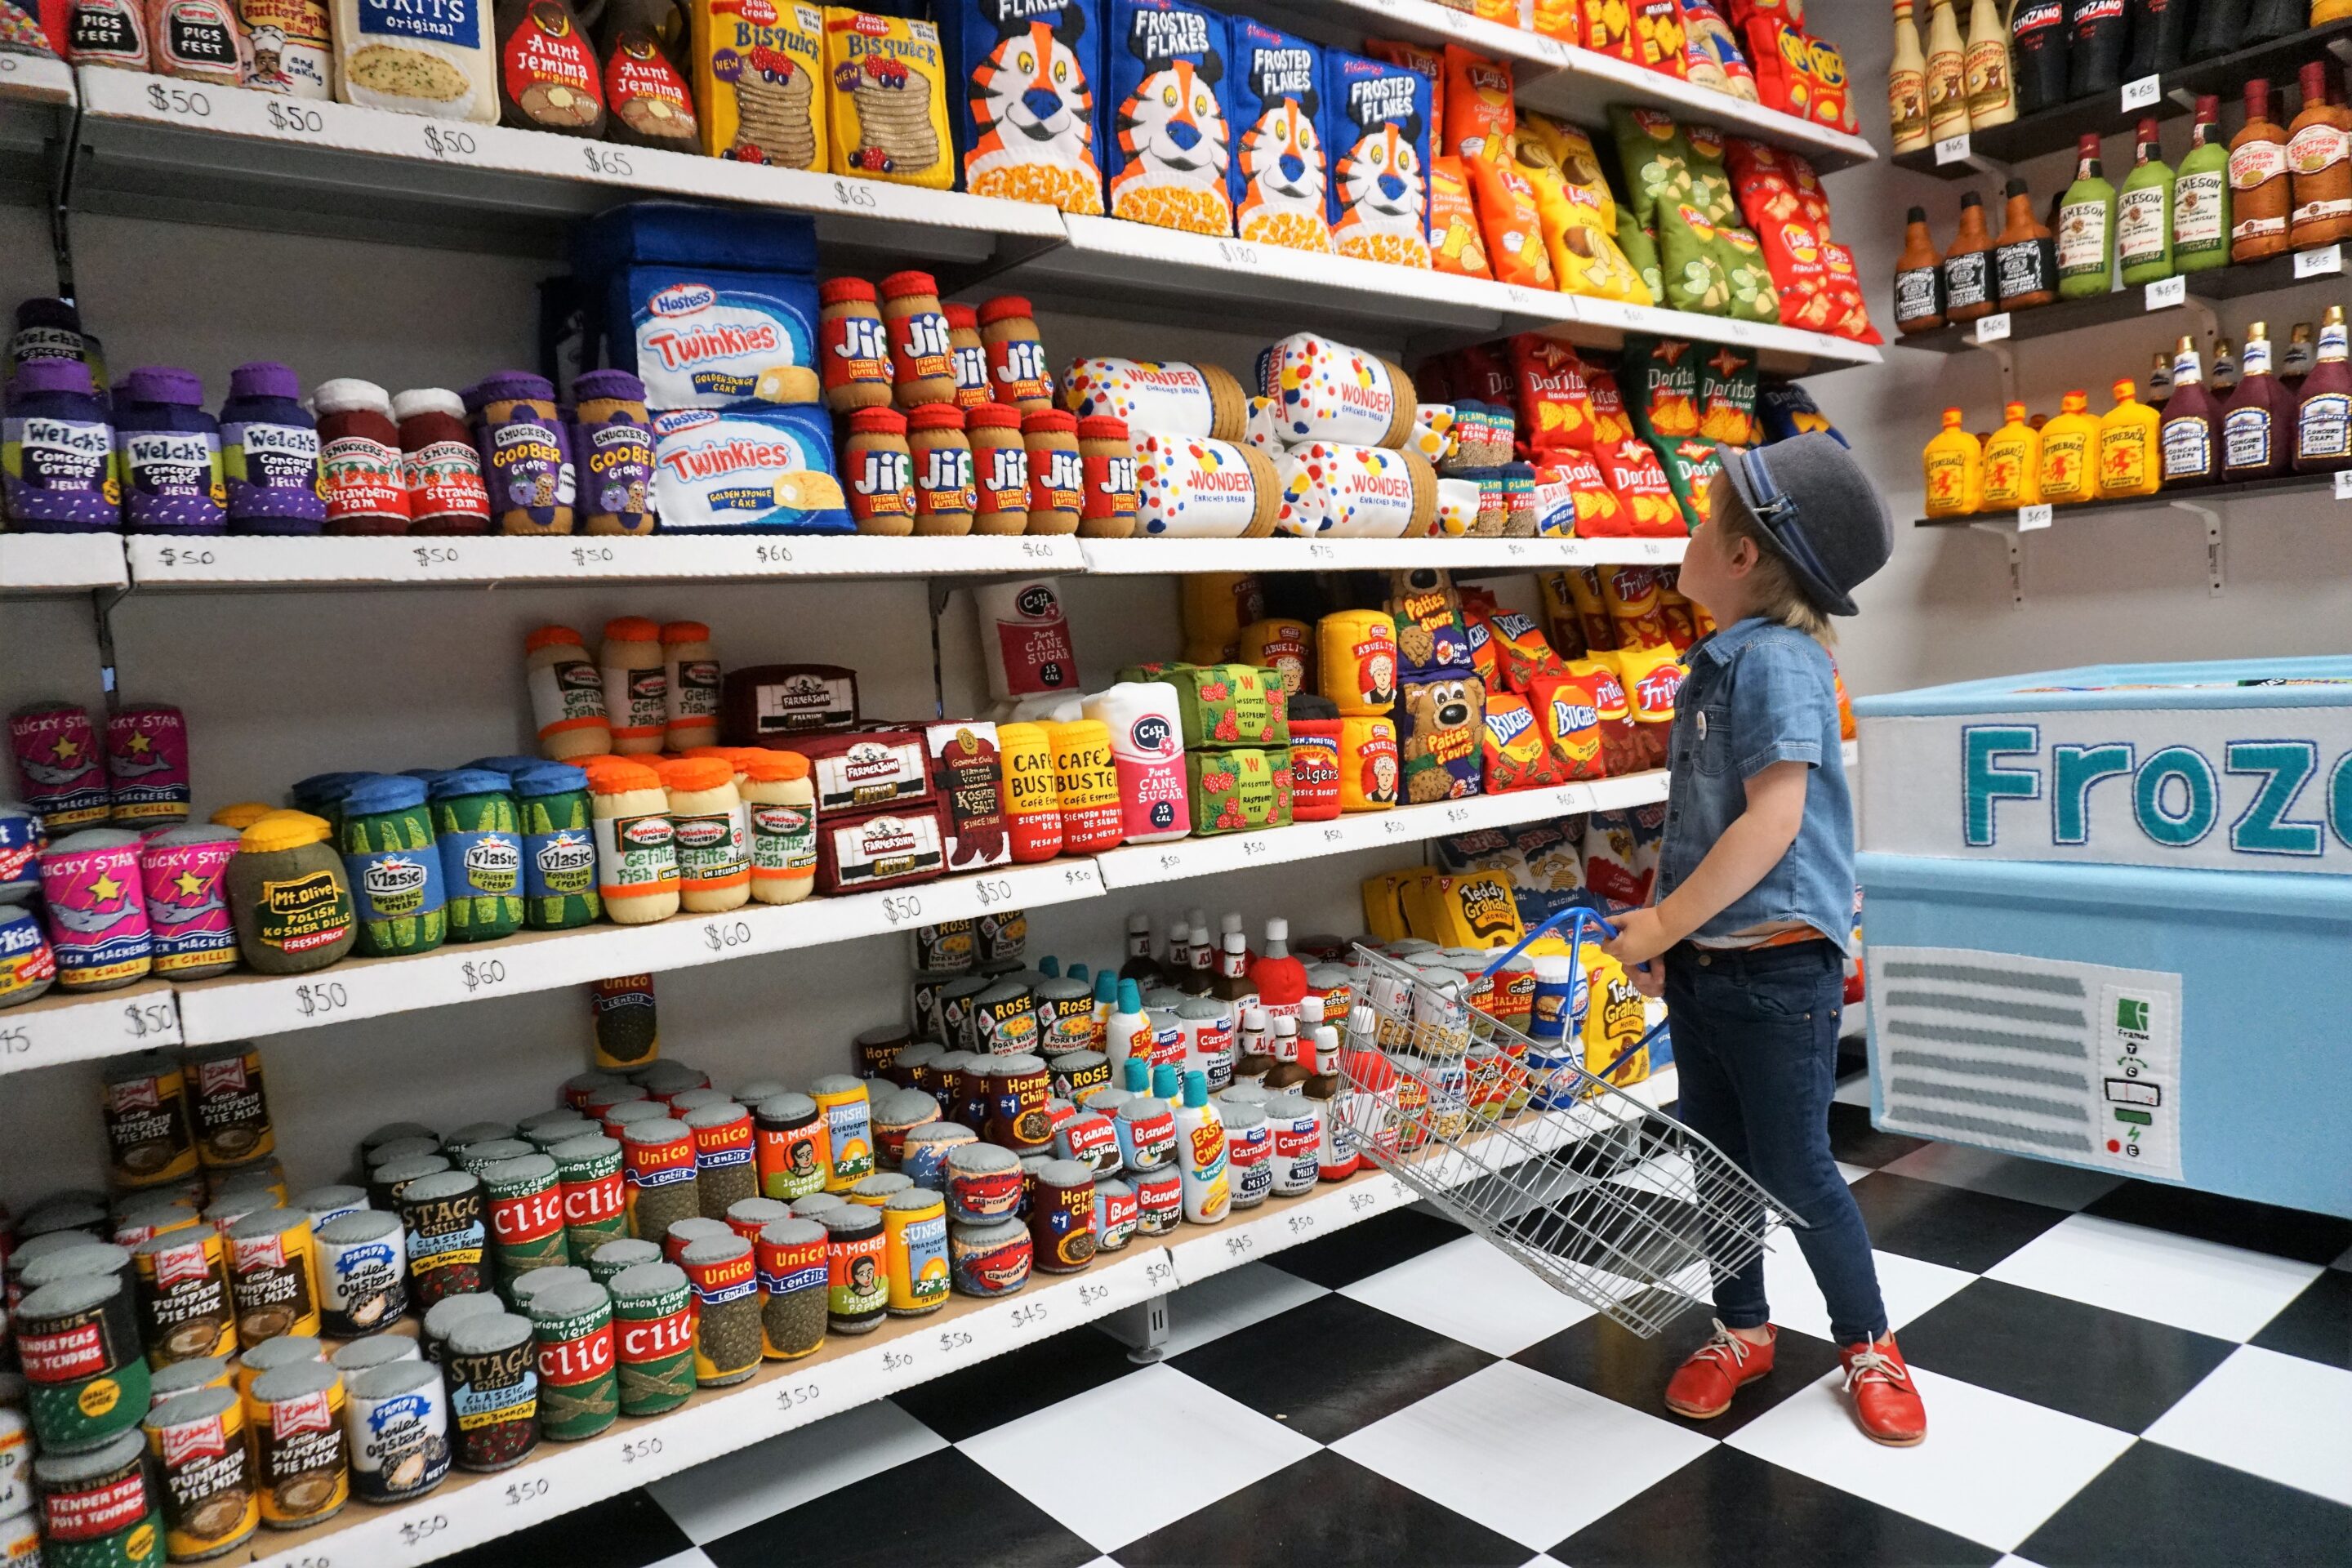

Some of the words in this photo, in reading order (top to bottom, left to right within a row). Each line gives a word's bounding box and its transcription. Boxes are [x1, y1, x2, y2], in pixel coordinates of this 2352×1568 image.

[1136, 10, 1206, 37] FROSTED
[2012, 7, 2060, 33] CINZANO
[183, 27, 220, 42] PIGS
[735, 23, 819, 64] Bisquick
[1146, 29, 1209, 58] FLAKES
[181, 41, 222, 56] FEET
[527, 34, 580, 61] Aunt
[291, 56, 314, 69] and
[518, 52, 589, 80] Jemima
[621, 63, 669, 80] Aunt
[715, 57, 738, 70] NEW
[1472, 66, 1508, 92] Lay's
[617, 79, 683, 100] Jemima
[1352, 77, 1415, 102] FROSTED
[148, 83, 211, 116] $50
[1361, 96, 1414, 123] FLAKES
[425, 125, 475, 156] $50
[584, 147, 632, 176] $65
[834, 181, 875, 207] $65
[1219, 242, 1258, 265] $180
[657, 292, 710, 313] Hostess
[835, 319, 887, 358] Jif
[904, 314, 949, 358] Jif
[649, 326, 775, 367] Twinkies
[851, 361, 878, 369] PEANUT
[852, 368, 879, 376] BUTTER
[997, 343, 1045, 382] Jif
[1124, 368, 1201, 387] WONDER
[713, 383, 737, 393] CAKE
[1146, 384, 1179, 394] ENRICHED
[1181, 386, 1200, 395] BREAD
[1702, 378, 1757, 399] Doritos
[1341, 381, 1391, 415] WONDER
[660, 410, 714, 430] Hostess
[29, 422, 107, 451] Welch's
[248, 430, 316, 452] Welch's
[497, 425, 553, 443] SMUCKERS
[595, 426, 648, 444] SMUCKERS
[2103, 430, 2145, 447] FIREBALL
[32, 450, 100, 467] Concord
[260, 454, 313, 469] Concord
[493, 443, 561, 467] GOOBER
[663, 442, 788, 480] Twinkies
[39, 462, 96, 479] Grape
[855, 452, 909, 494] Jif
[50, 479, 89, 491] JELLY
[1192, 470, 1253, 492] WONDER
[1352, 474, 1410, 498] WONDER
[326, 488, 398, 504] Strawberry
[342, 497, 376, 509] Jam
[710, 492, 739, 501] GOLDEN
[740, 489, 772, 499] SPONGE
[158, 548, 216, 566] $50
[572, 547, 612, 566] $50
[756, 545, 793, 563] $60
[1022, 541, 1053, 556] $60
[1310, 545, 1334, 559] $75
[1405, 594, 1445, 621] Pattes
[1420, 608, 1454, 631] d'ours
[1241, 676, 1254, 689] W
[143, 715, 180, 728] STAR
[1486, 708, 1533, 746] BUGLES
[1140, 725, 1164, 738] C&H
[1148, 768, 1171, 777] Pure
[1139, 777, 1178, 791] CANE
[1316, 788, 1339, 797] ROAST
[1063, 794, 1086, 804] Café
[1138, 788, 1183, 802] SUGAR
[972, 800, 994, 815] SALT
[1064, 811, 1099, 822] SIEMPRO
[1159, 805, 1169, 814] 15
[1249, 805, 1260, 813] TEA
[964, 819, 986, 829] SINCE
[1084, 819, 1094, 828] DE
[1096, 817, 1119, 827] SABOR
[1156, 814, 1171, 822] CAL
[755, 837, 804, 853] Gefilte
[1071, 832, 1093, 843] PESO
[1095, 830, 1116, 840] NETO
[754, 854, 782, 867] Fish
[617, 866, 653, 884] Fish
[977, 880, 1012, 906] $50
[1459, 880, 1505, 902] Teddy
[1465, 899, 1512, 917] Grahams
[1548, 895, 1579, 907] ORIGINAL
[287, 905, 336, 924] POLISH
[263, 923, 320, 938] KOSHER
[323, 911, 350, 932] DILLS
[705, 922, 751, 951] $60
[94, 942, 151, 961] MACKEREL
[95, 963, 140, 978] CHILLI
[462, 960, 505, 991] $60
[296, 982, 347, 1017] $50
[996, 997, 1031, 1019] ROSE
[125, 1004, 173, 1038] $50
[992, 1040, 1013, 1049] PORK
[1001, 1098, 1016, 1112] #1
[1021, 1089, 1045, 1105] Chili
[1071, 1125, 1114, 1147] Banner
[1192, 1121, 1221, 1146] EASY
[639, 1145, 688, 1165] Unico
[1083, 1144, 1118, 1159] SAUSAGE
[653, 1169, 687, 1183] Lentils
[1141, 1183, 1181, 1205] Banner
[421, 1217, 467, 1236] CHILI
[416, 1232, 470, 1249] CLASSIC
[345, 1245, 386, 1263] PAMPA
[777, 1246, 824, 1267] Unico
[344, 1263, 387, 1282] boiled
[1146, 1263, 1171, 1287] $50
[151, 1281, 220, 1312] PUMPKIN
[171, 1281, 202, 1297] Easy
[158, 1308, 187, 1324] PIE
[191, 1297, 221, 1314] MIX
[616, 1298, 654, 1310] Turions
[657, 1300, 684, 1316] Vert
[1011, 1303, 1048, 1329] $45
[622, 1438, 662, 1463] $50
[51, 1492, 110, 1512] TENDER
[113, 1477, 144, 1496] PEAS
[89, 1494, 145, 1524] TENDRES
[399, 1515, 448, 1545] $50
